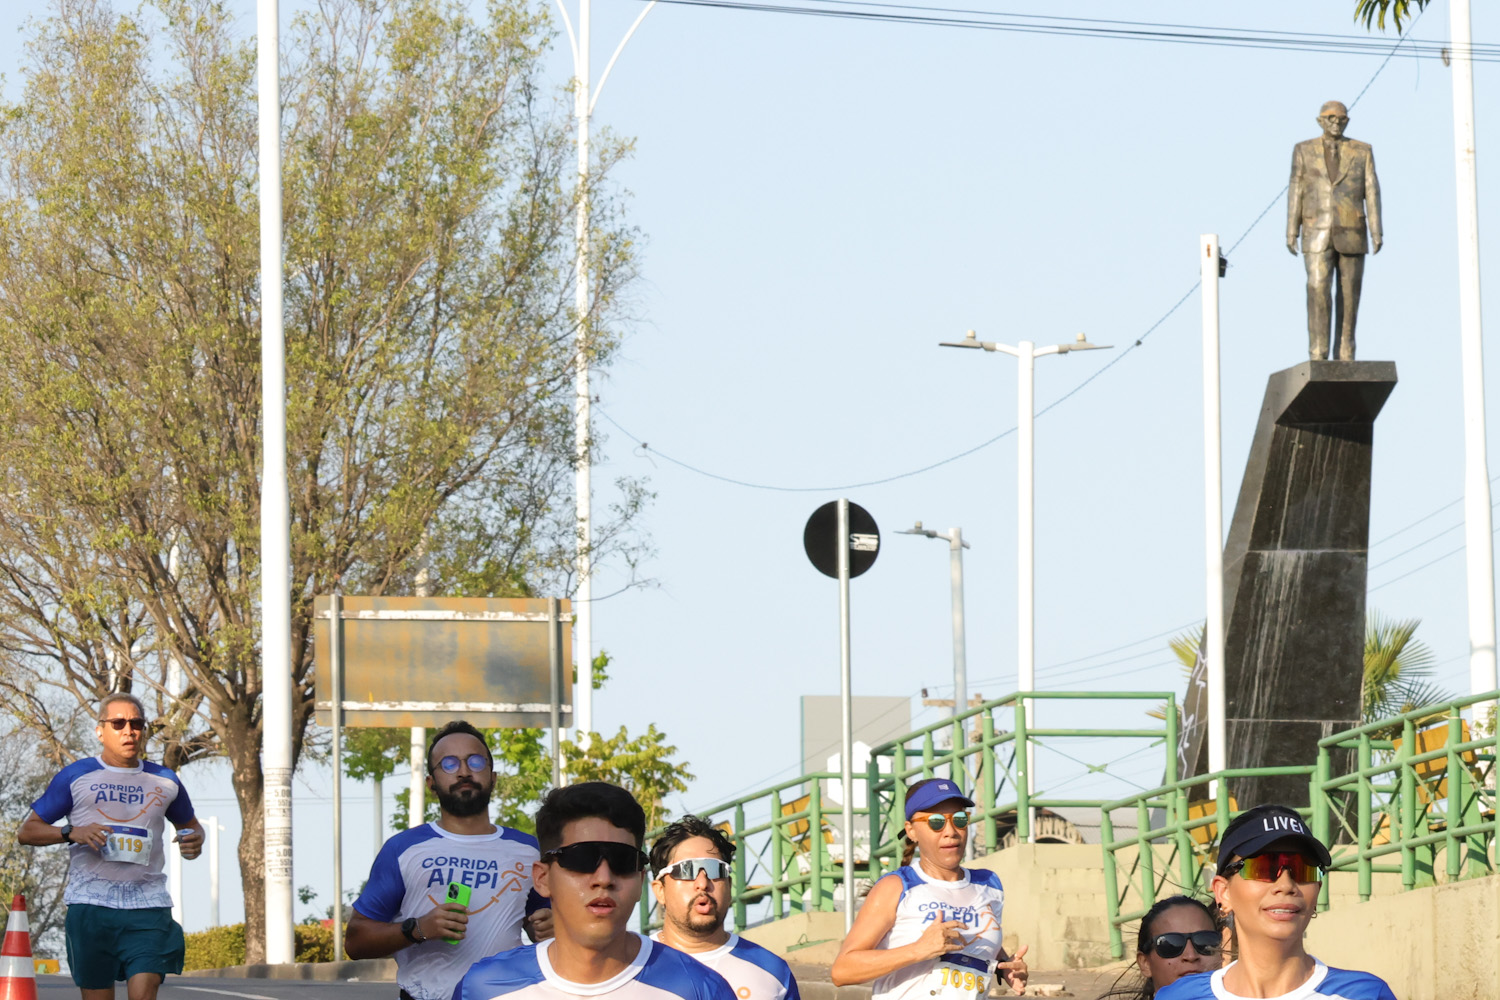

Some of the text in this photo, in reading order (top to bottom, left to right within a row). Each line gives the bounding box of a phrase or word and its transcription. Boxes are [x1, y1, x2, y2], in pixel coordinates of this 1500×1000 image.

[90, 783, 143, 793] CORRIDA
[95, 790, 144, 805] ALEPI
[422, 856, 498, 871] CORRIDA
[941, 966, 985, 995] 1096
